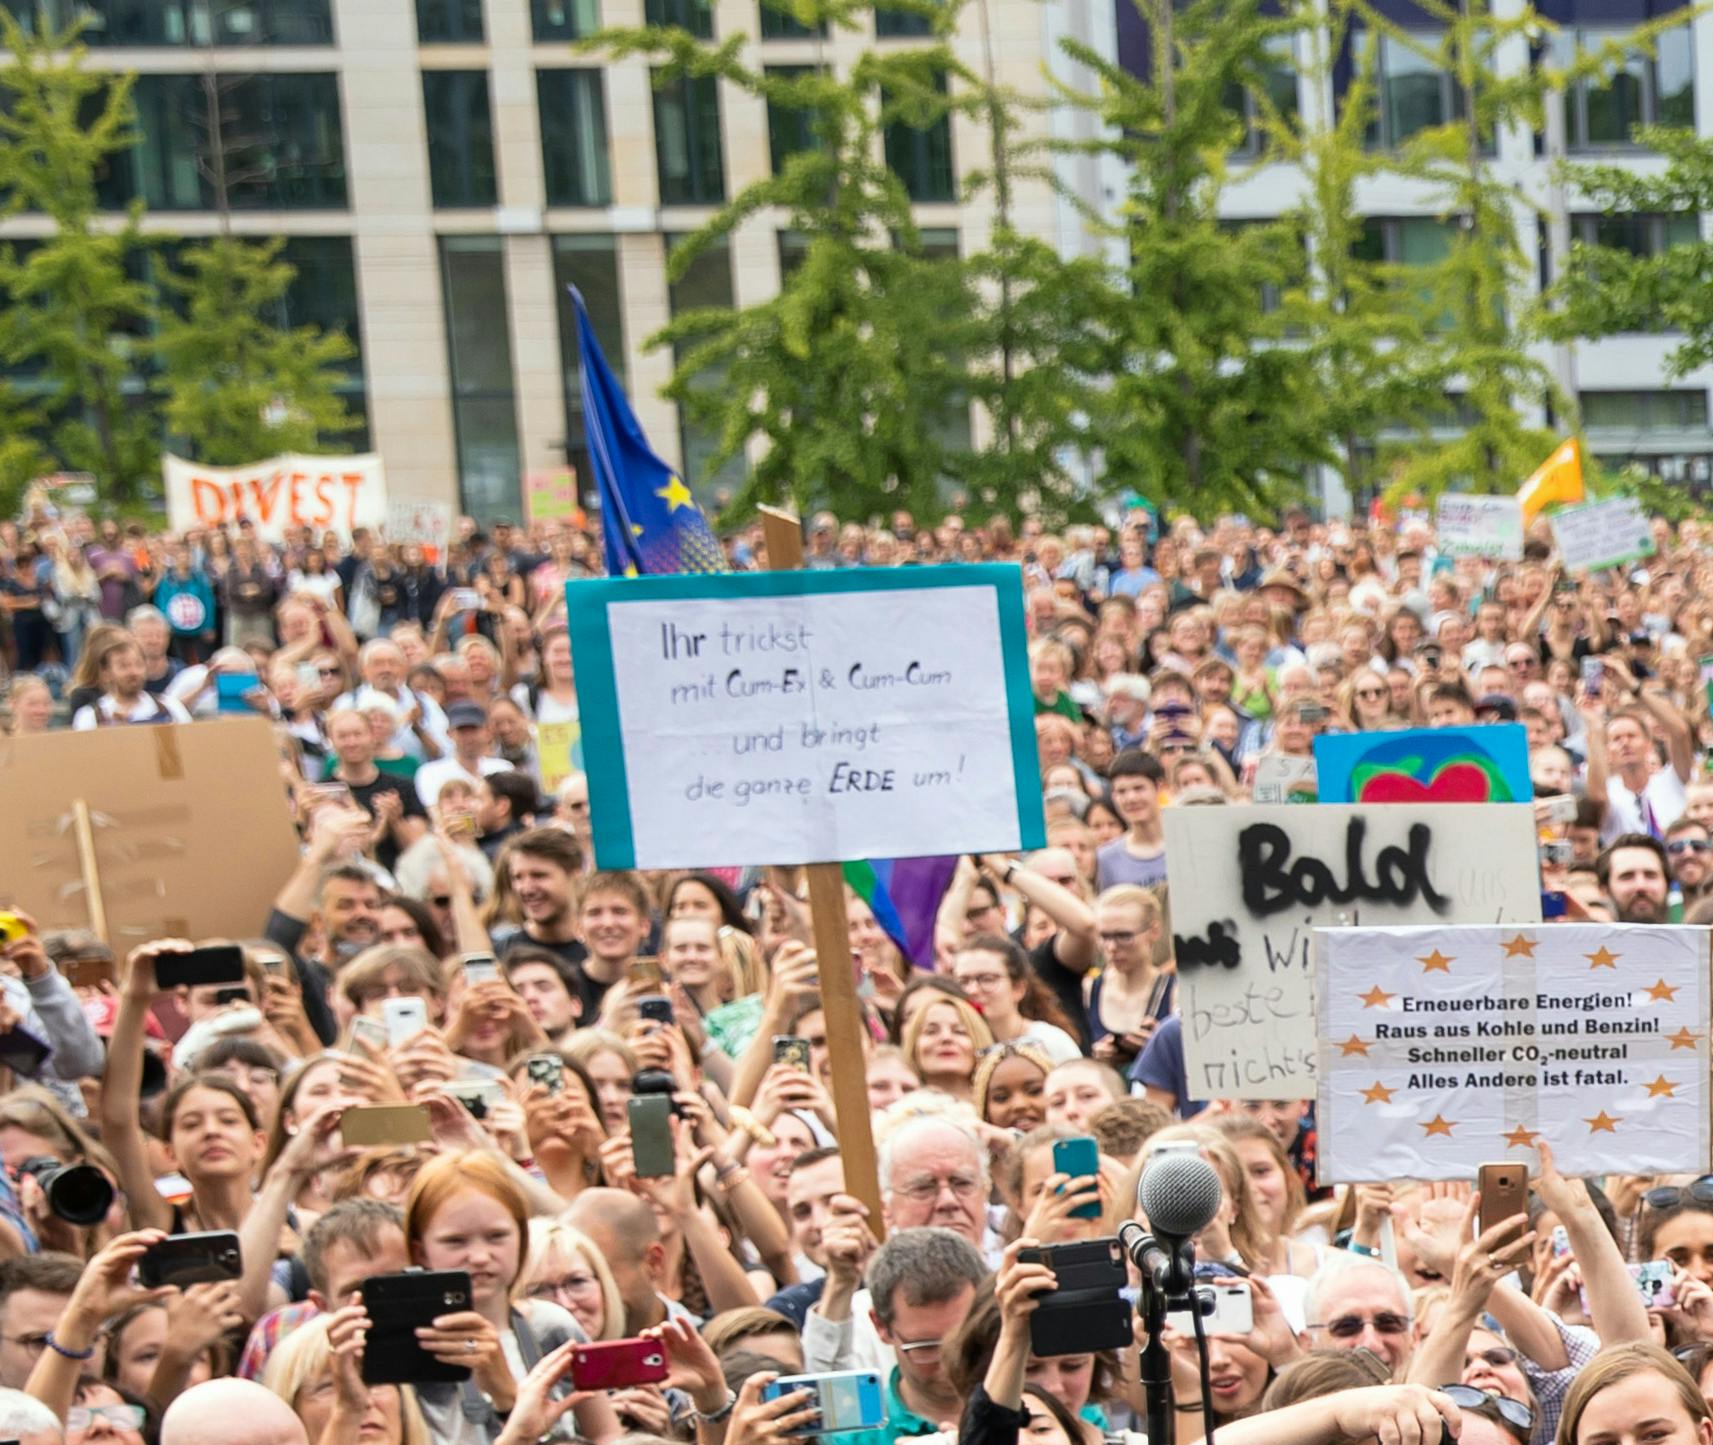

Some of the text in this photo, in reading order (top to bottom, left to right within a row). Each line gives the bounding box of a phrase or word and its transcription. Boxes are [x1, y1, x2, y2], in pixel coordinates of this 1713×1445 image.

[190, 472, 365, 528] DIVEST
[661, 622, 814, 660] Ihr trickst
[671, 660, 952, 704] mit Cum-Ex & Cum-Cum
[732, 721, 882, 756] und bringt
[684, 774, 726, 802] die
[734, 777, 812, 809] ganze
[828, 760, 896, 794] ERDE
[1238, 814, 1453, 920] Bald
[1402, 992, 1633, 1014] Erneuerbare Energien!
[1375, 1017, 1660, 1040] Raus aus Kohle und Benzin!
[1407, 1046, 1506, 1064] Schneller
[1407, 1067, 1630, 1089] Alles Andere ist fatal.
